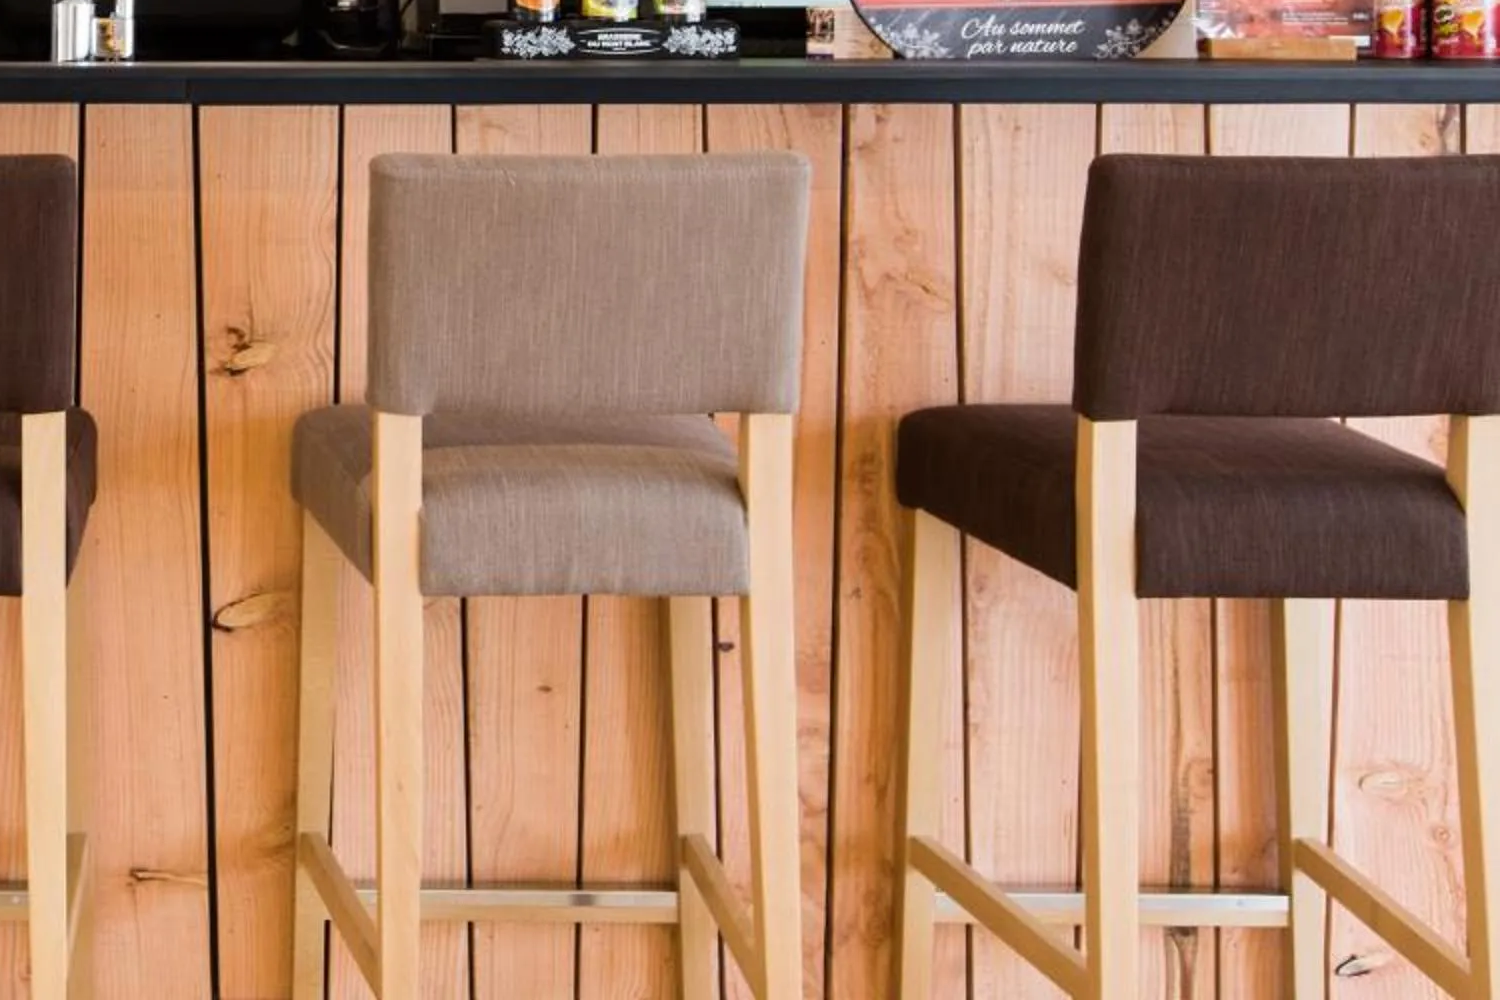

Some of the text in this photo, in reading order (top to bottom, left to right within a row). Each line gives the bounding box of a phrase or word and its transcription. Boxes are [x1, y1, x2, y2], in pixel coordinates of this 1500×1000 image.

[961, 14, 1087, 40] Au sommet
[966, 38, 1078, 59] par nature
